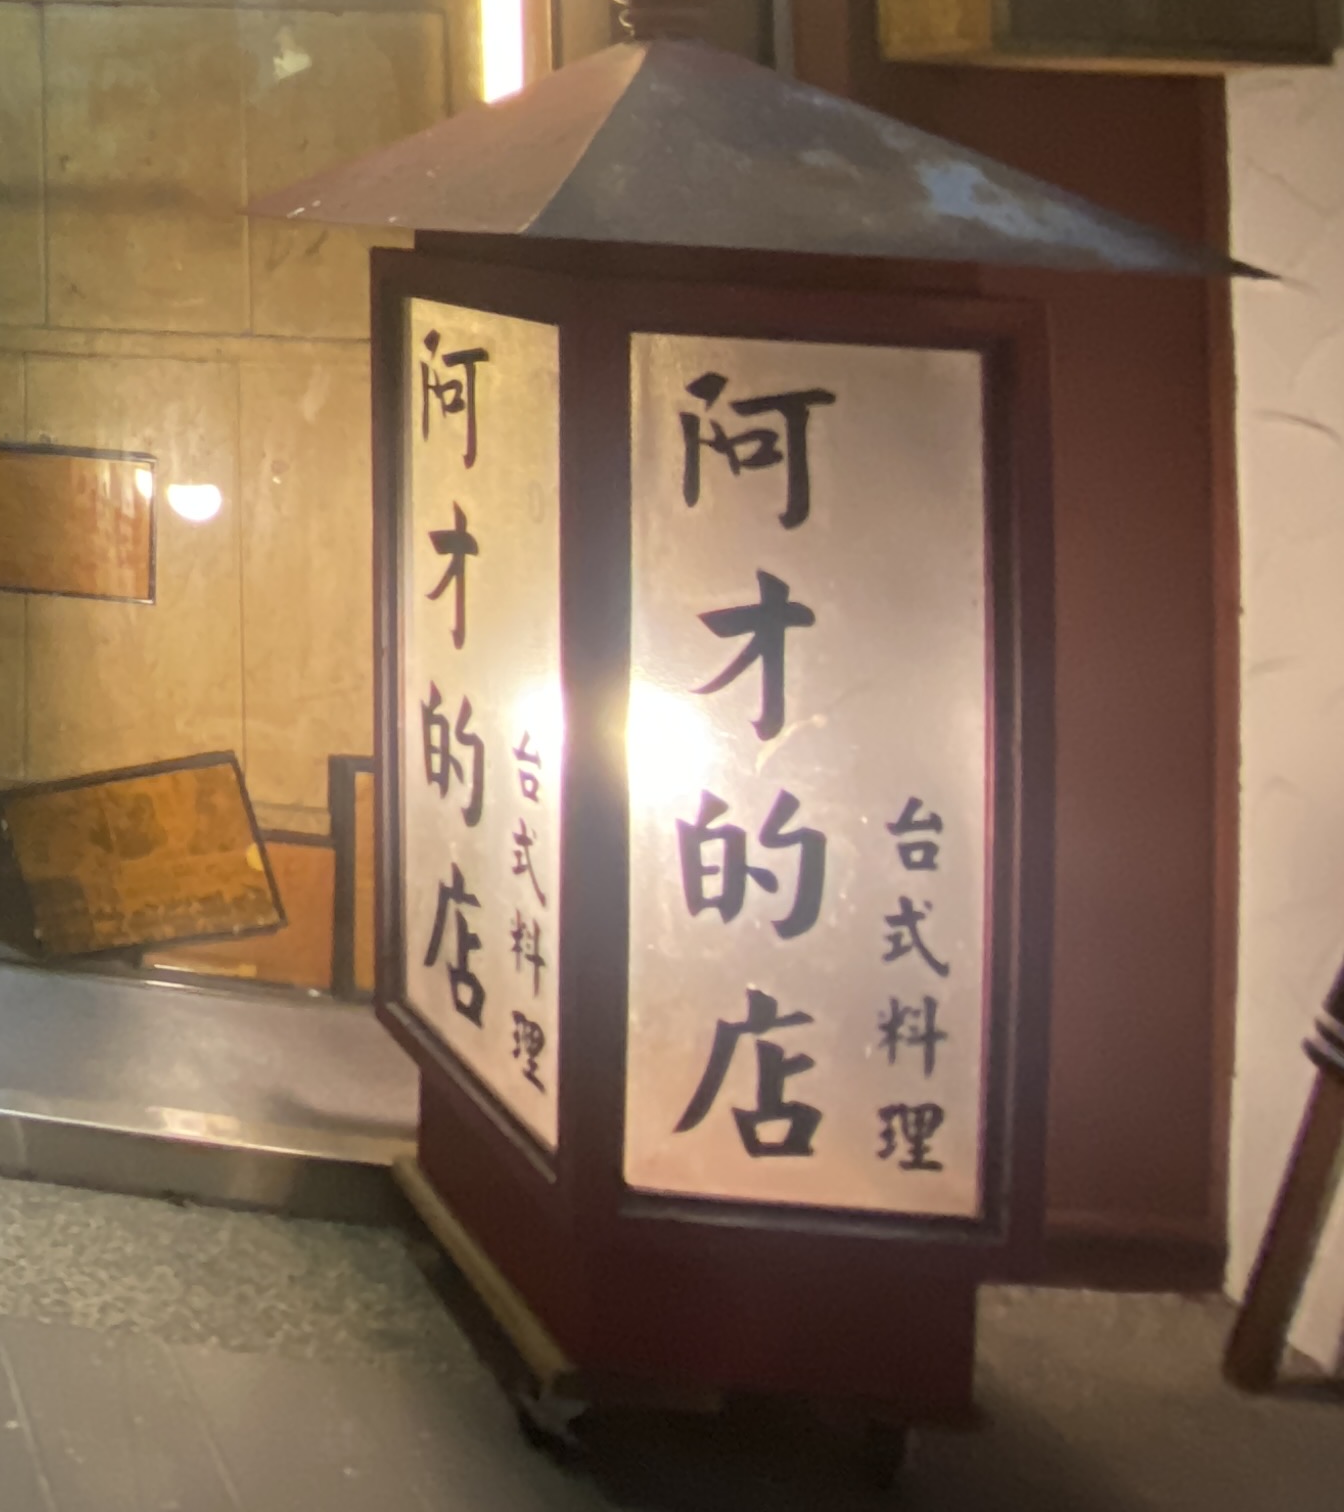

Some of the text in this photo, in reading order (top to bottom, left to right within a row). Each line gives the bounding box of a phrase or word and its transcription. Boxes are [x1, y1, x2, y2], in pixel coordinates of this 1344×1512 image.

[420, 330, 490, 1030] 阿才的店
[510, 730, 548, 1096] 台式料理
[672, 370, 836, 1160] 阿才的店
[874, 796, 951, 1174] 台式料理
